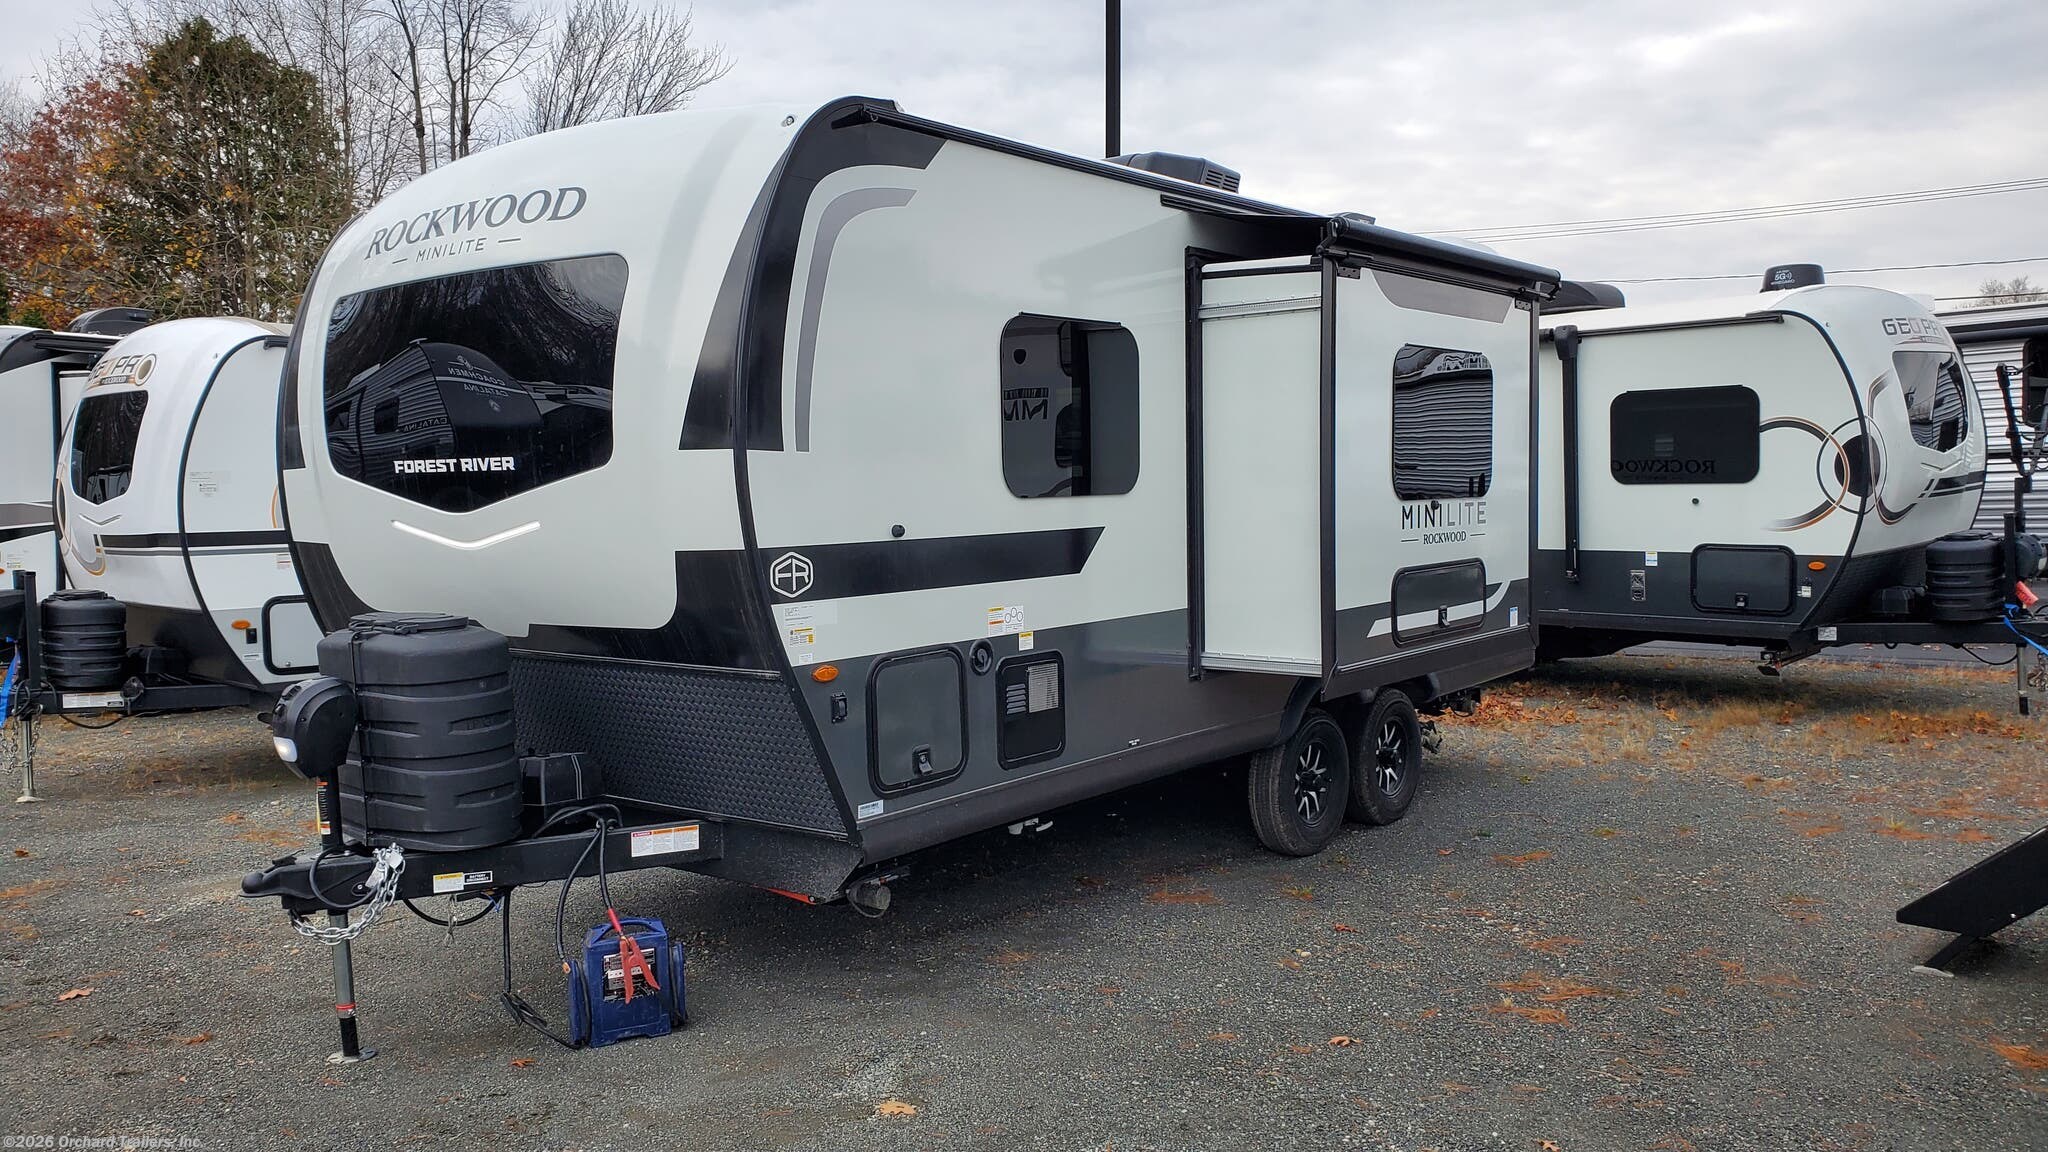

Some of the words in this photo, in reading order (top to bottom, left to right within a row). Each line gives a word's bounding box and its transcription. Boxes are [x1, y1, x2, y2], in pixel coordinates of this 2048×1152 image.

[364, 186, 588, 261] ROCKWOOD
[416, 237, 487, 262] MINILITE
[110, 353, 157, 387] PRO
[393, 459, 457, 474] FOREST
[459, 456, 515, 472] RIVER
[1401, 501, 1487, 530] MINILITE
[1423, 530, 1467, 545] ROCKWOOD
